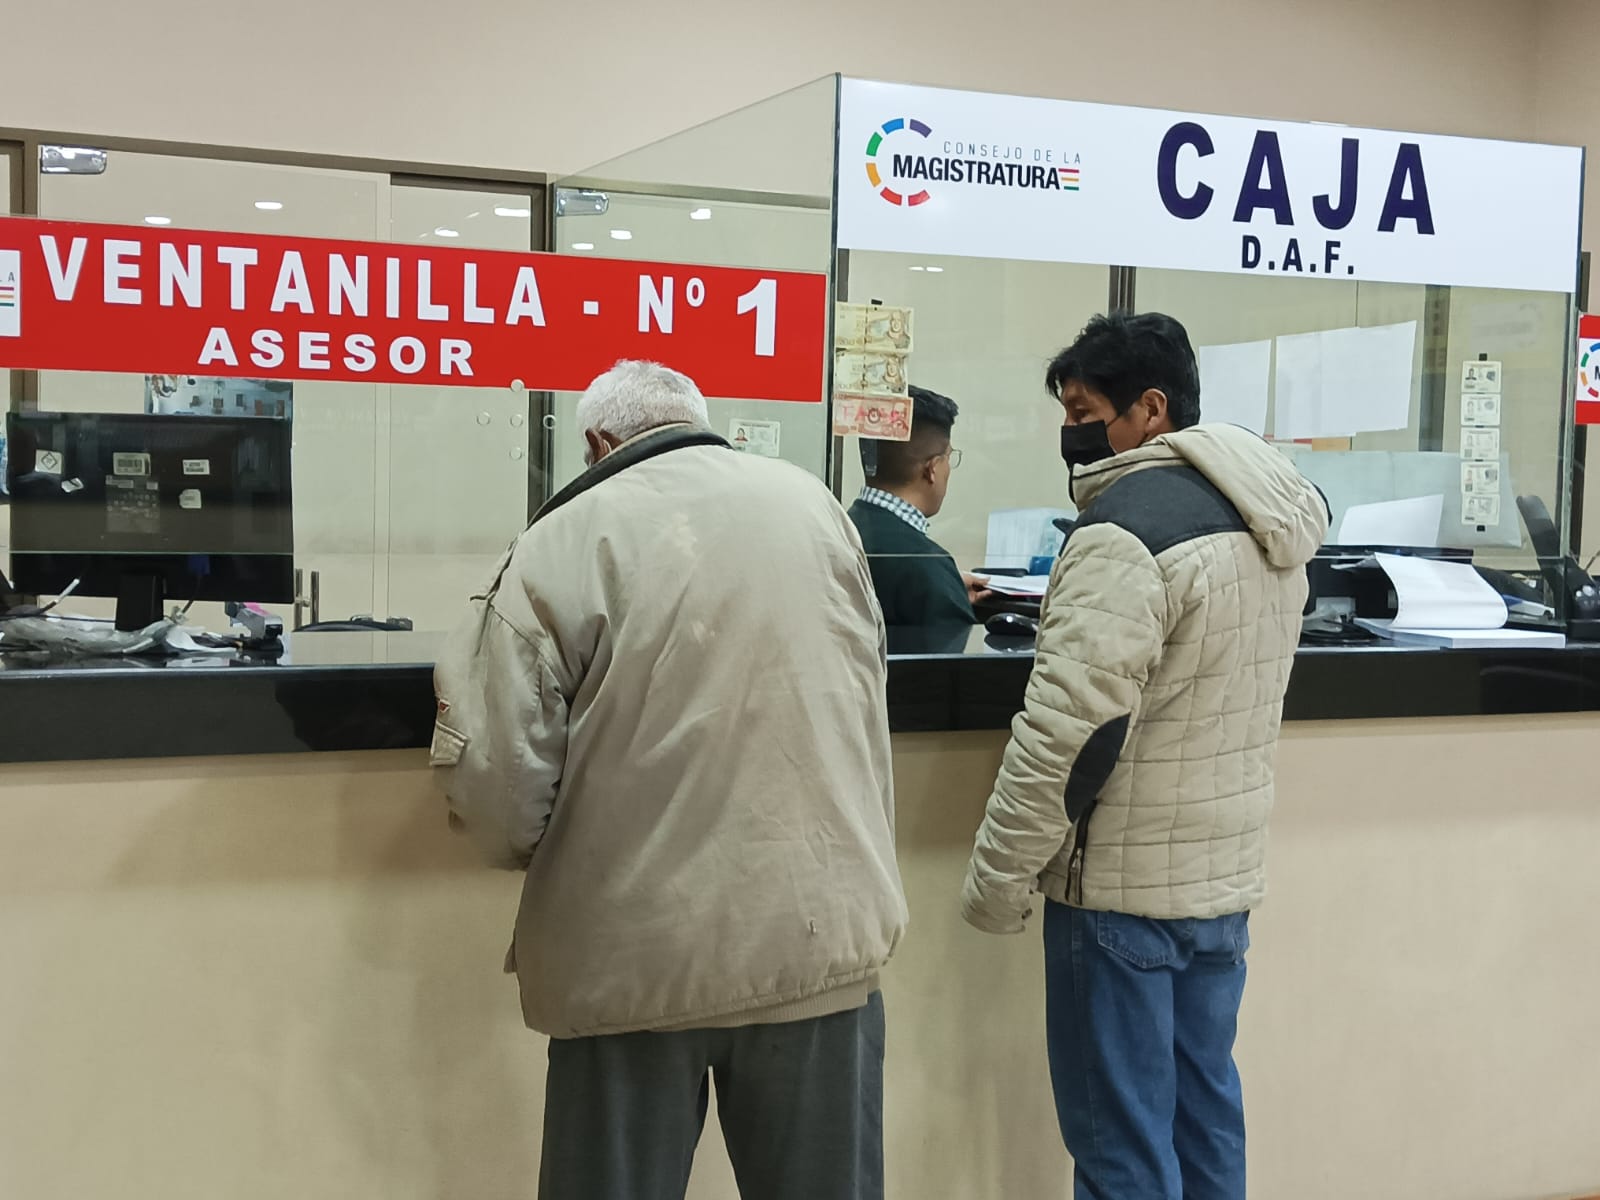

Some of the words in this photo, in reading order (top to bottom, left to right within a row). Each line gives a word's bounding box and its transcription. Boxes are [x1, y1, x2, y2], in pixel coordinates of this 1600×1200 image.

[893, 154, 1061, 190] MAGISTRATURA
[943, 140, 1023, 160] CONSEJO
[1034, 148, 1053, 163] DE
[1063, 152, 1081, 165] LA
[1157, 121, 1436, 236] CAJA
[1241, 234, 1355, 275] D.A.F.
[39, 234, 546, 327] VENTANILLA
[583, 300, 599, 315] -
[737, 278, 777, 357] 1
[198, 327, 475, 376] ASESOR
